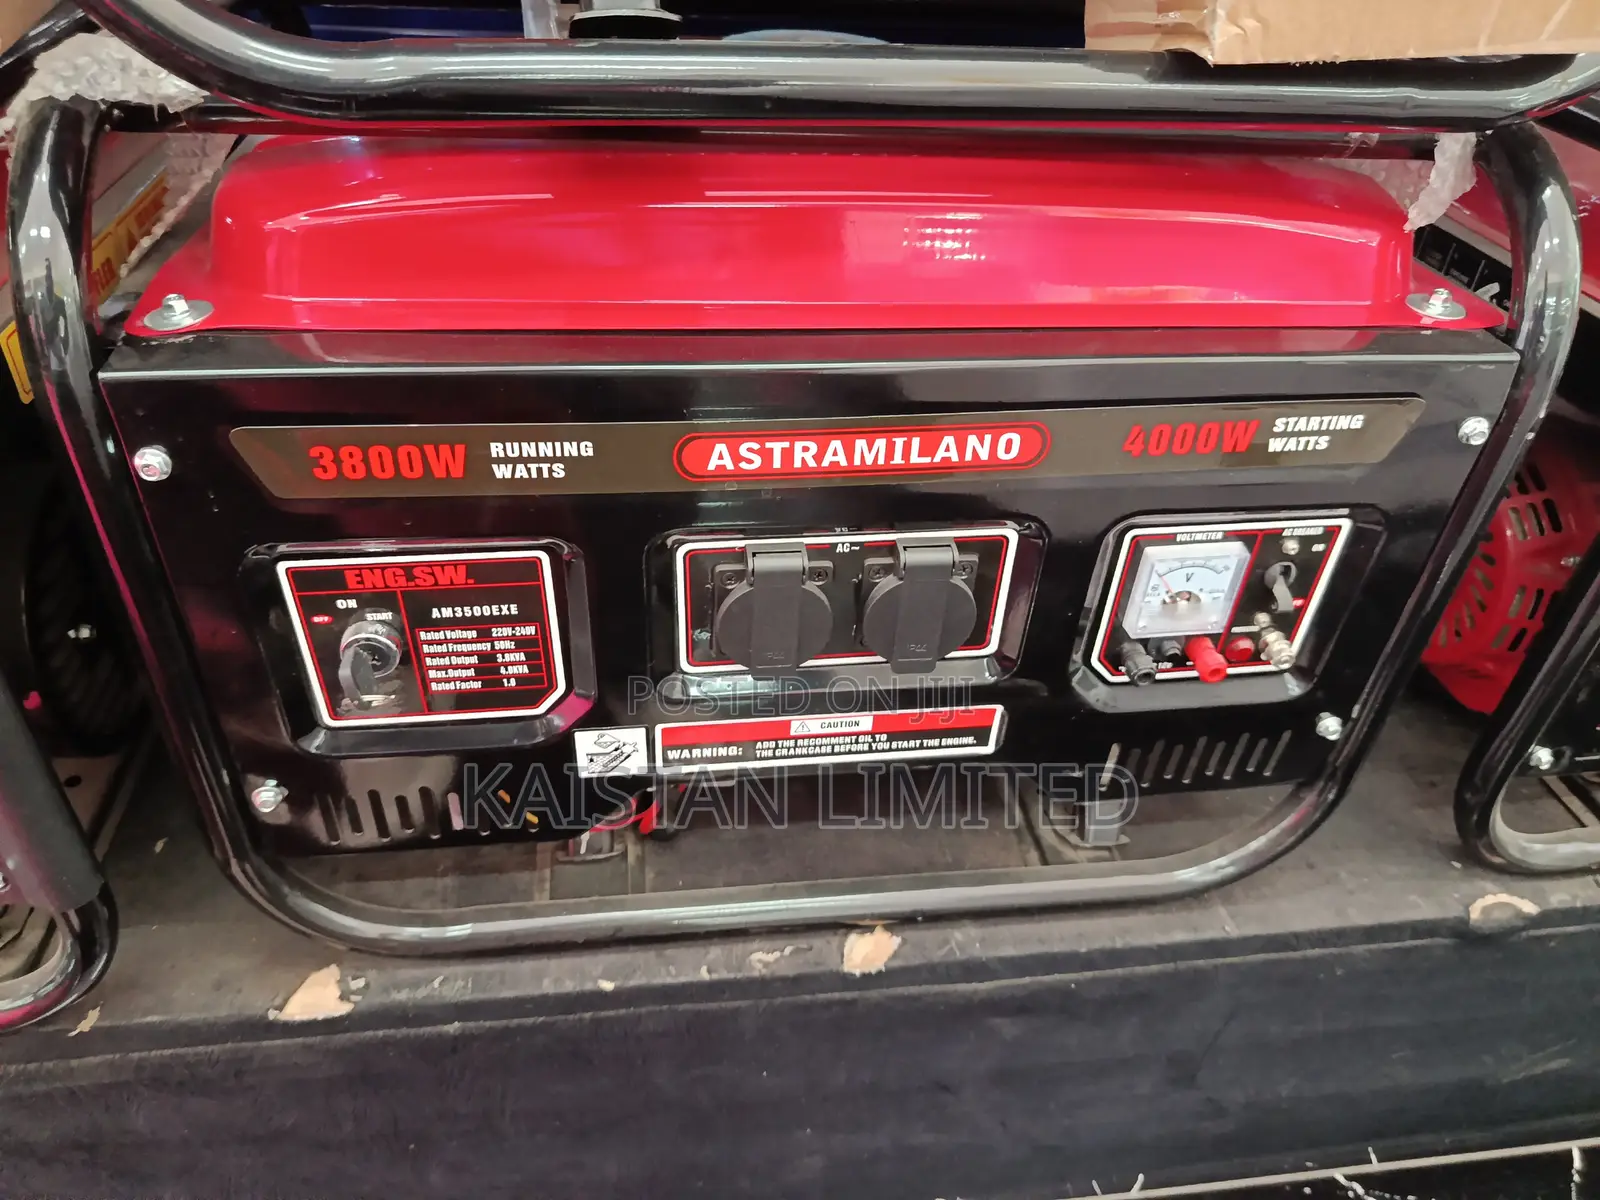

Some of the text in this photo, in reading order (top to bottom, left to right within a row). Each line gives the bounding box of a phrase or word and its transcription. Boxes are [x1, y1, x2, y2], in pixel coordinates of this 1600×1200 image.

[1272, 414, 1365, 433] STARTING
[1122, 419, 1261, 458] 4000W
[1267, 435, 1332, 453] WATTS
[489, 441, 594, 459] RUNNING
[706, 432, 1022, 471] ASTRAMILANO
[309, 443, 467, 481] 3800W
[491, 462, 566, 479] WATTS
[1175, 531, 1224, 542] VOLTMETER
[344, 564, 475, 589] ENG.SW.
[1185, 572, 1195, 583] V
[335, 598, 358, 610] ON
[431, 604, 519, 619] AM3500EXE
[365, 612, 393, 621] START
[419, 631, 445, 641] Rated
[445, 629, 477, 639] Voltage
[422, 640, 516, 654] Rated Frequency 50Hz
[425, 656, 450, 666] Rated
[450, 654, 478, 665] Output
[427, 667, 475, 679] Max.Output
[430, 677, 516, 691] Rated Factor 1.0
[820, 720, 861, 730] CAUTION
[756, 733, 888, 750] ADD THE RECOMMENT OIL TO
[756, 736, 977, 758] THE CRANKCASE BEFORE YOU START THE ENGINE.
[667, 745, 744, 760] WARNING:
